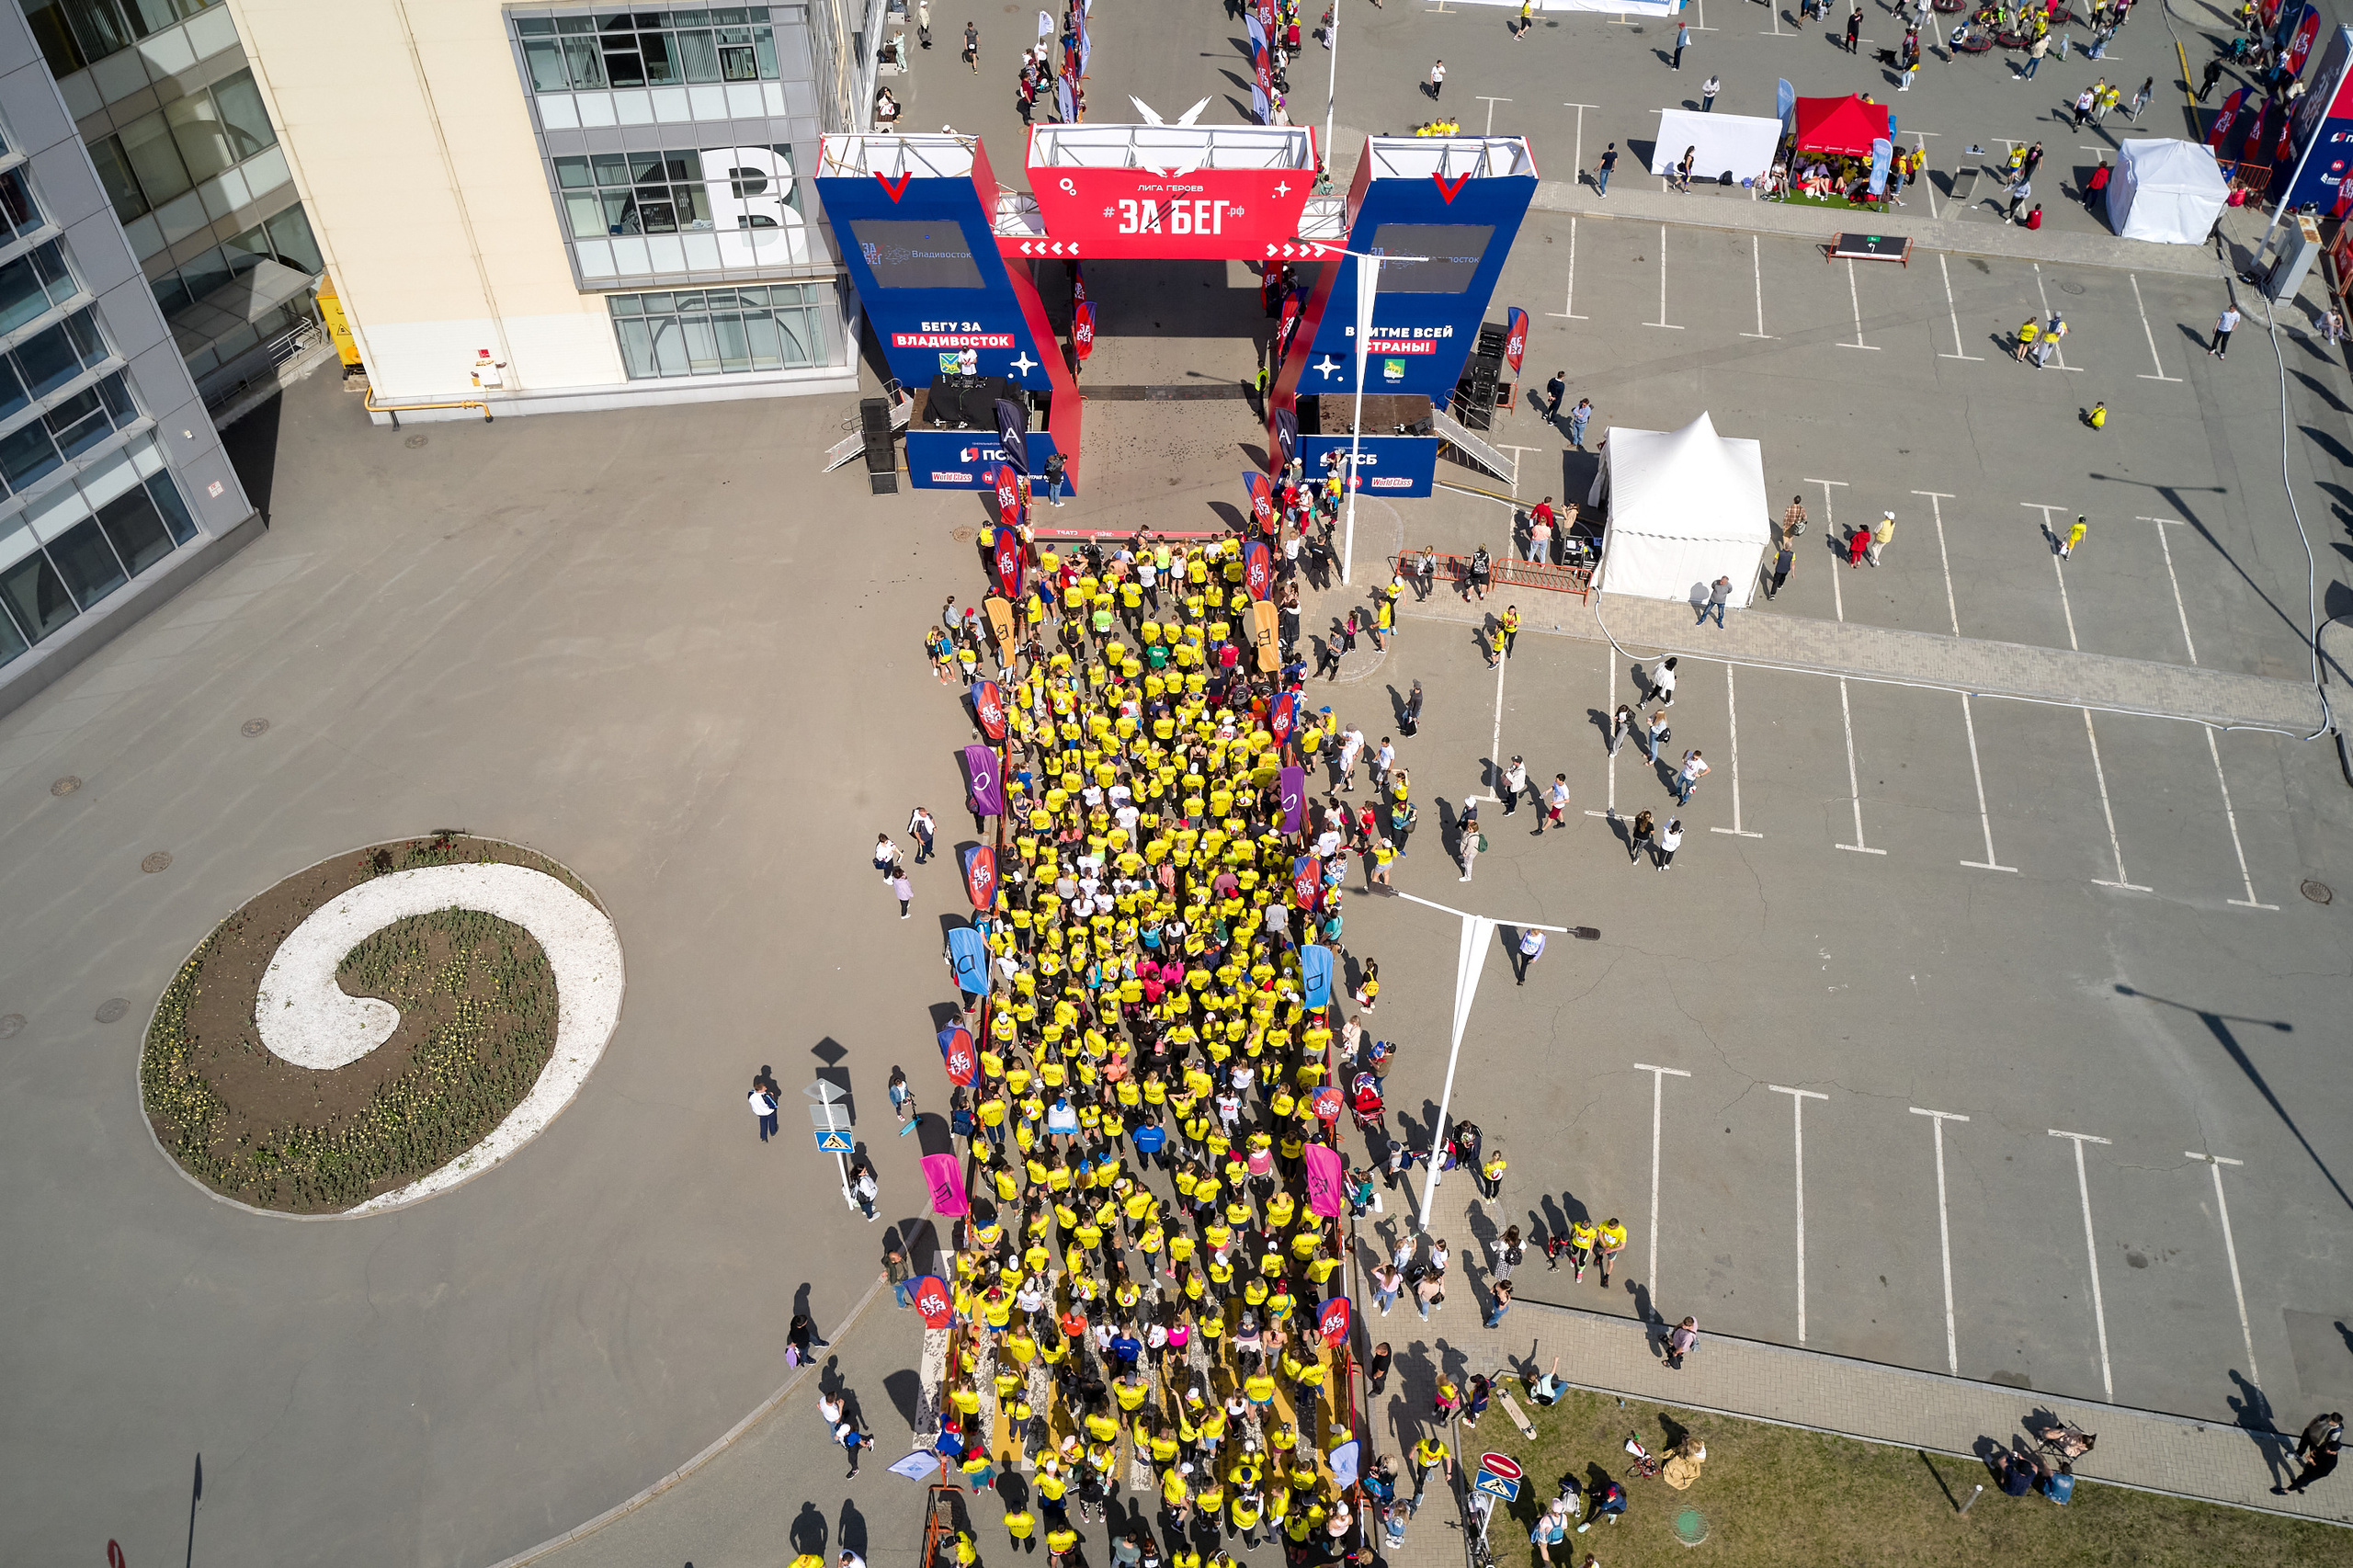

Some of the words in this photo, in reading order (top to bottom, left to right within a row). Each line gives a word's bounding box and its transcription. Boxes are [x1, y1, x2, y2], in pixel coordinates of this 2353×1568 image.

[912, 250, 972, 259] Владивосток
[921, 322, 958, 332] БЕГУ
[961, 322, 982, 332] ЗА
[1345, 326, 1356, 336] В
[1365, 326, 1412, 337] ИТМЕ
[1414, 324, 1454, 338] ВСЕЙ
[896, 335, 1009, 347] ВЛАДИВОСТОК
[983, 449, 1007, 461] ПС
